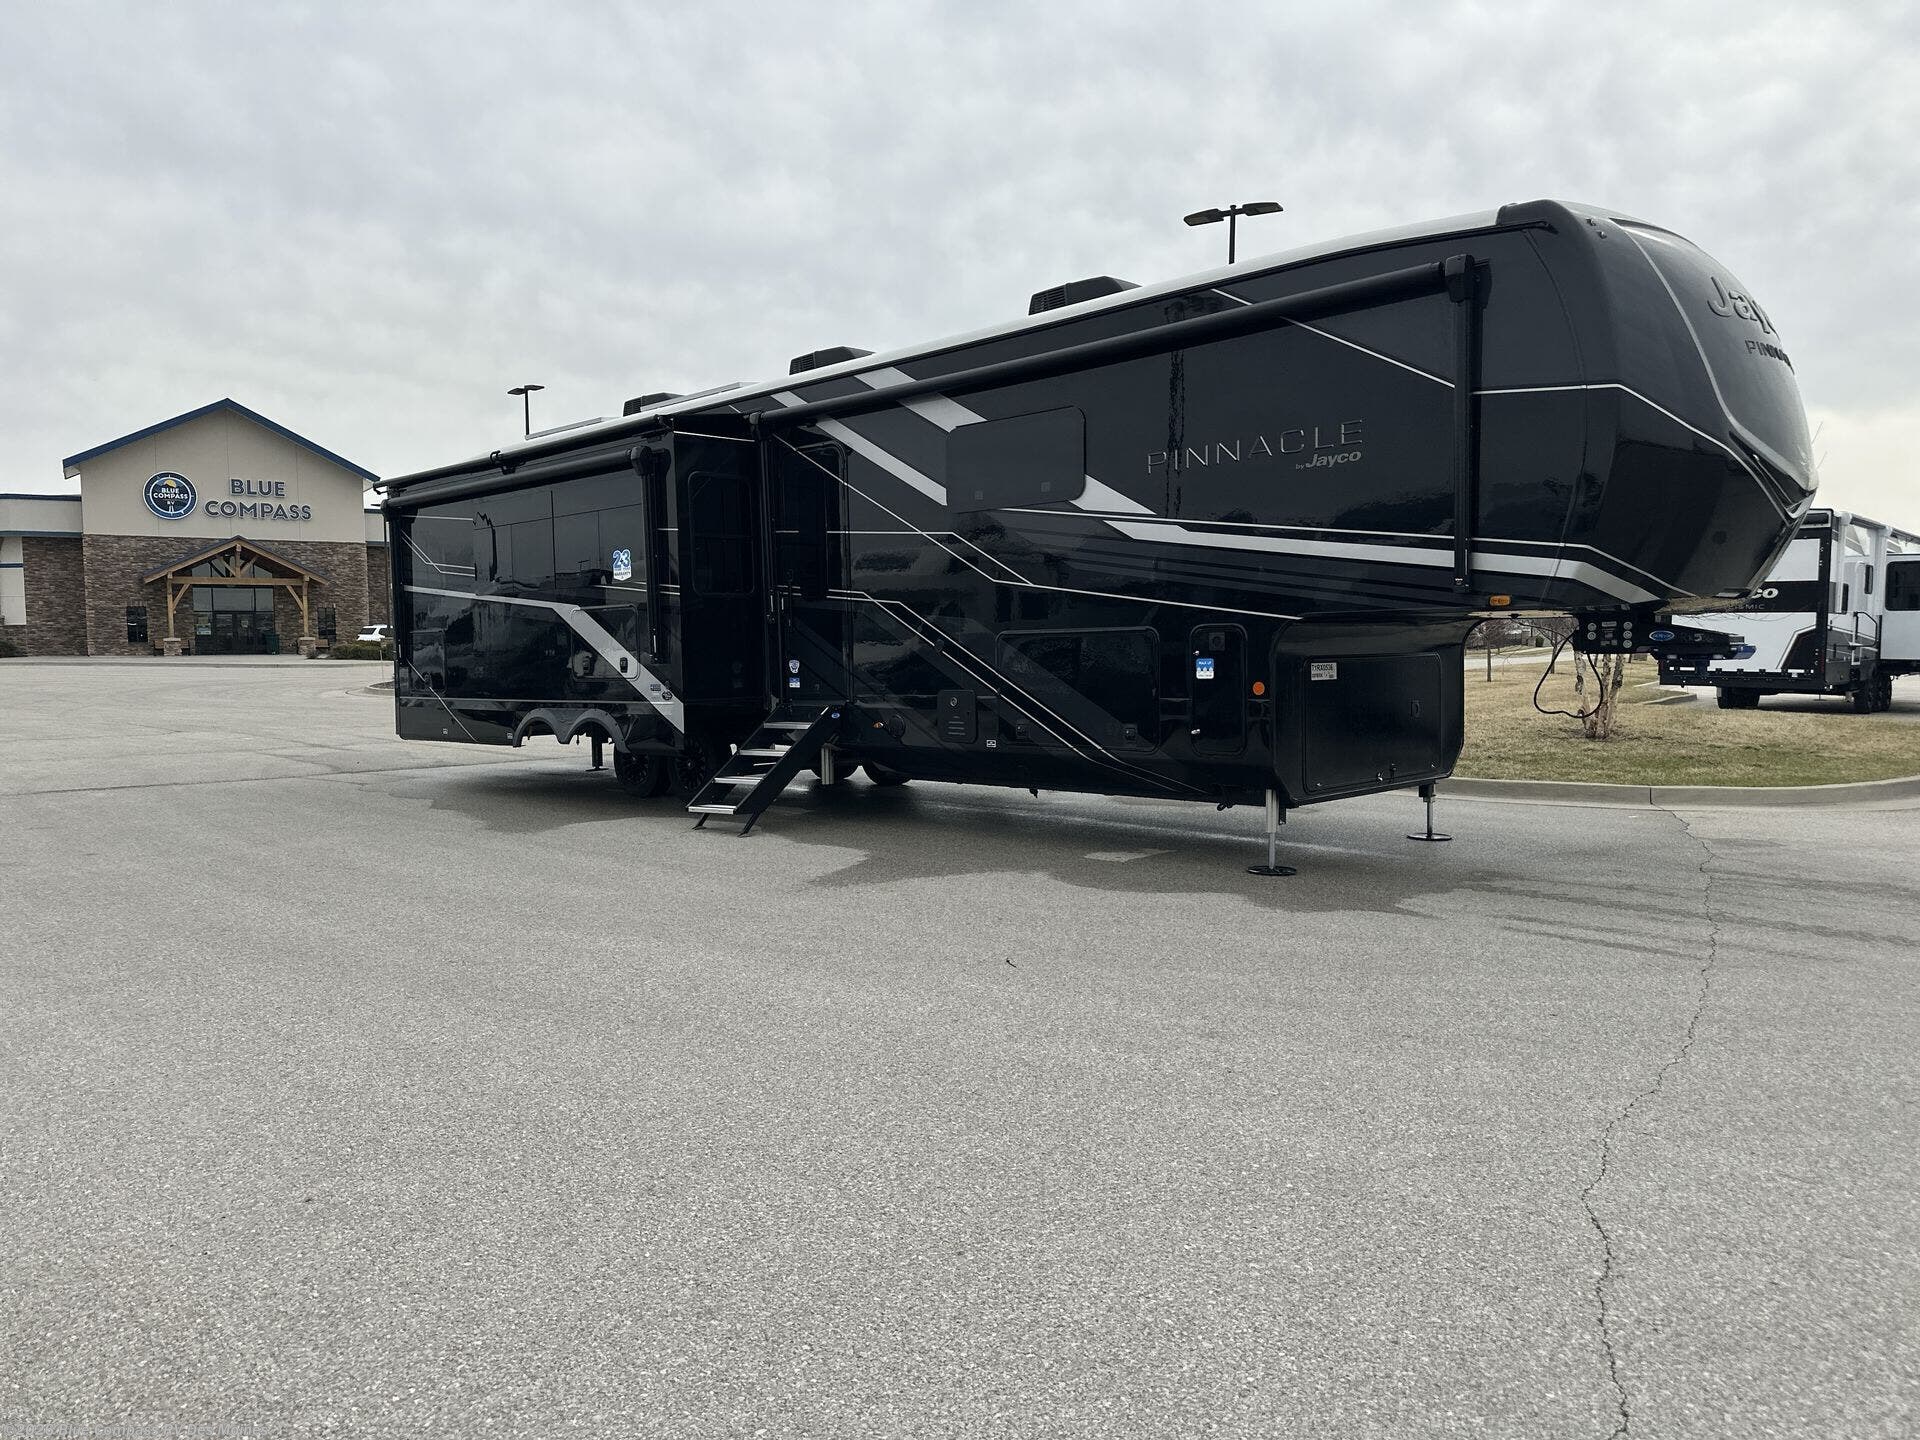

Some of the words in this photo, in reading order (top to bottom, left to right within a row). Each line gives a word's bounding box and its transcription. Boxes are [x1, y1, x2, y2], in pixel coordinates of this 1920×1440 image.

[1147, 419, 1362, 474] PINNACLE
[1305, 451, 1362, 468] Jayco
[153, 492, 188, 500] COMPASS
[231, 478, 285, 497] BLUE
[204, 500, 312, 520] COMPASS
